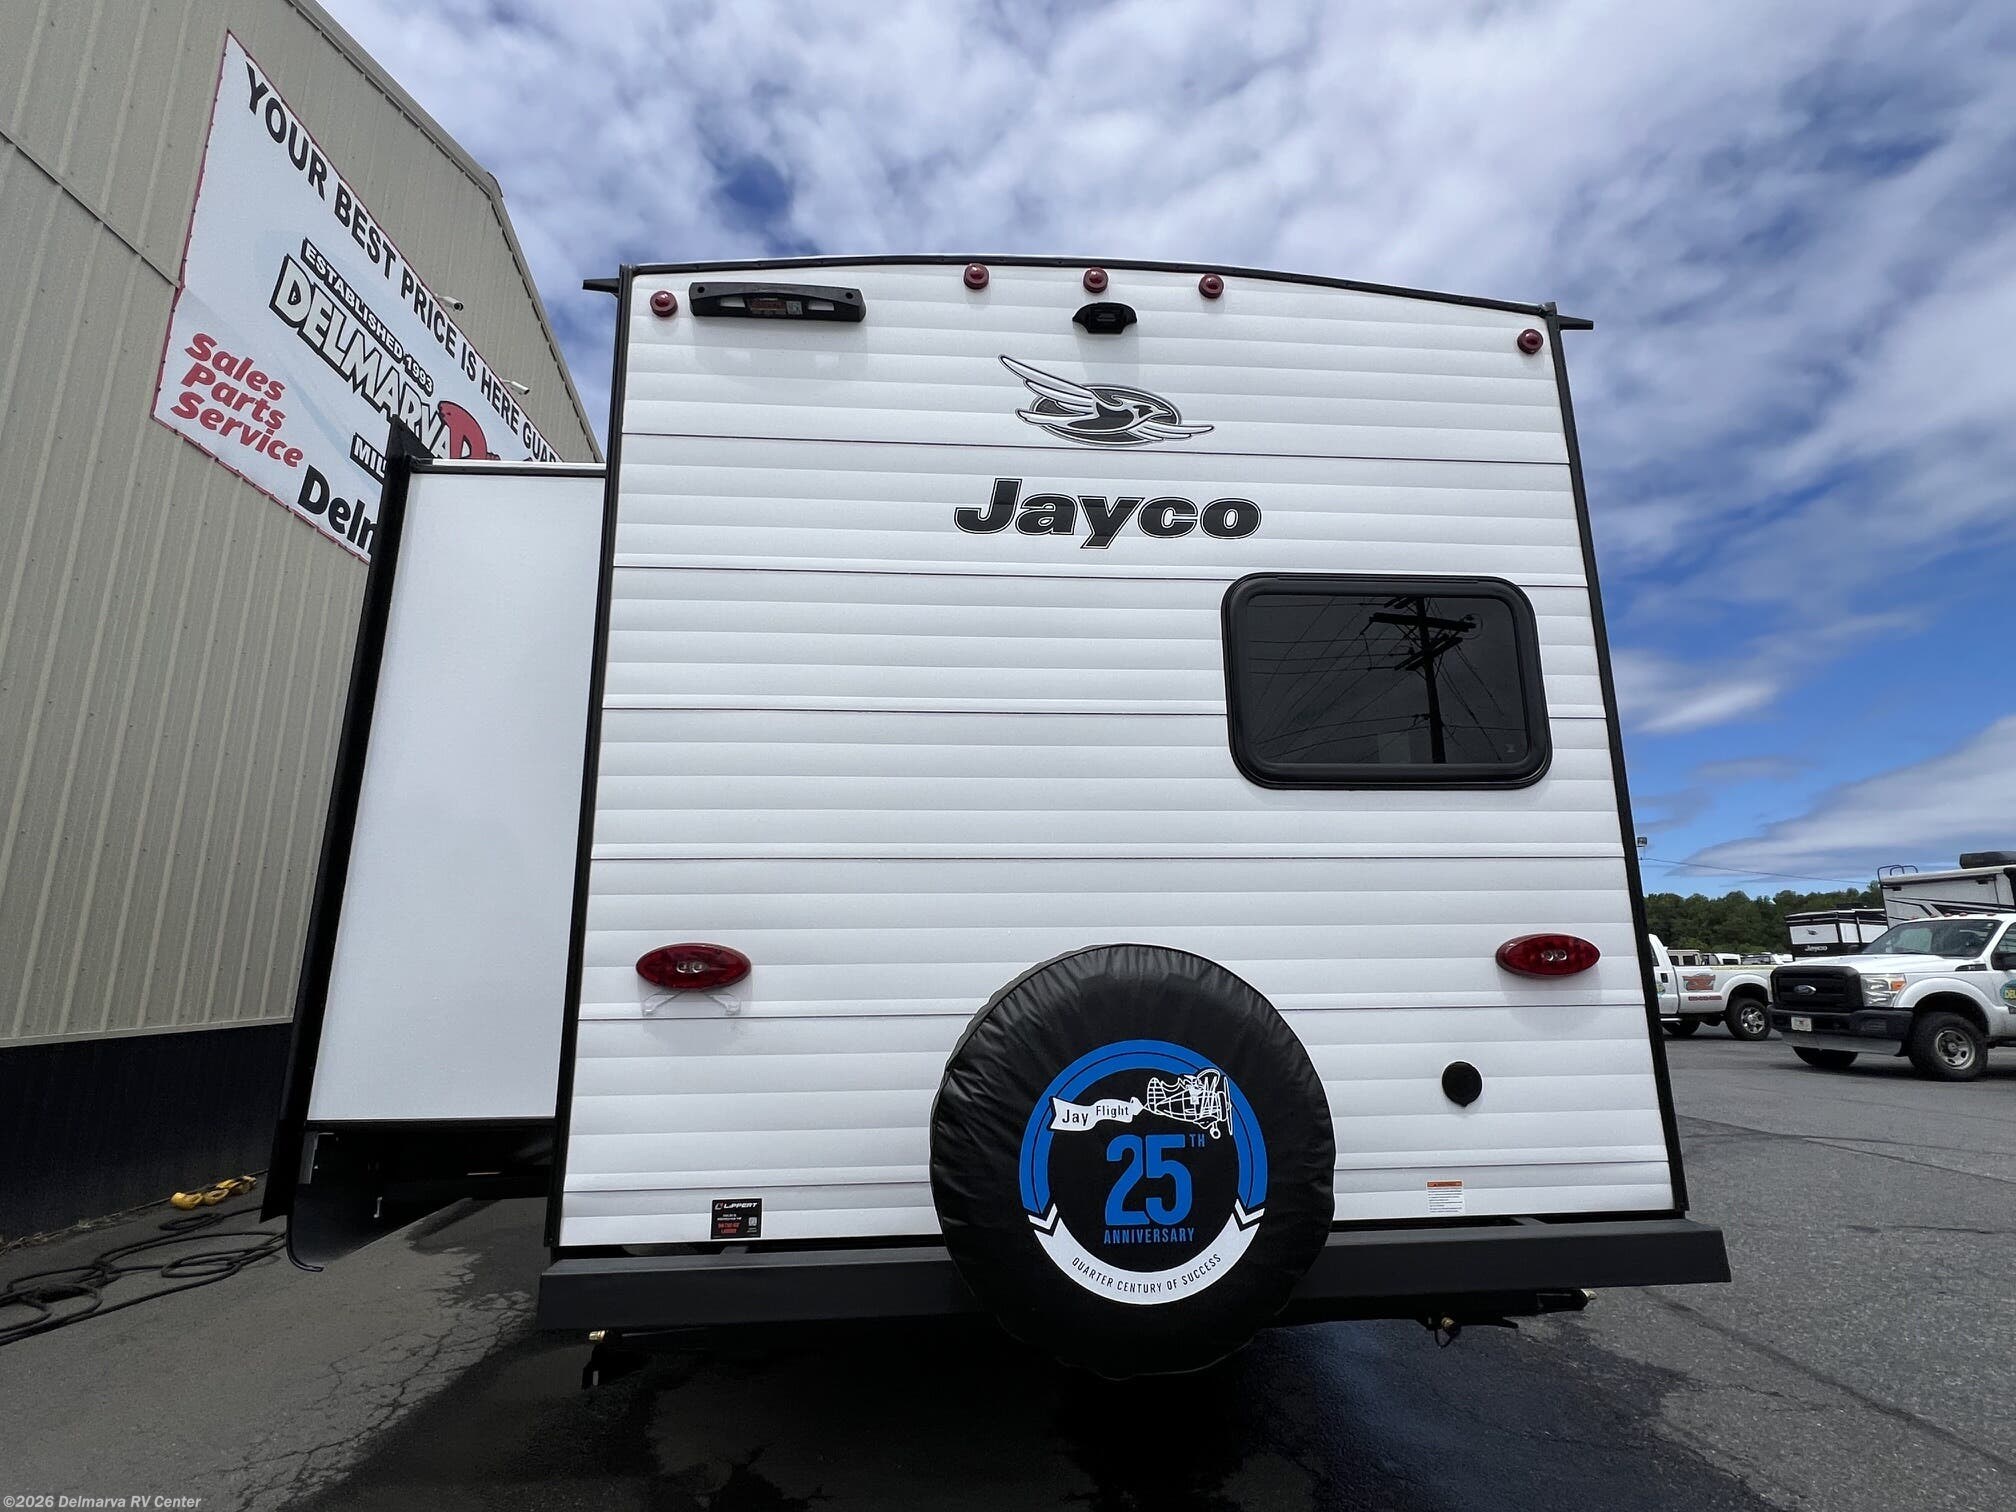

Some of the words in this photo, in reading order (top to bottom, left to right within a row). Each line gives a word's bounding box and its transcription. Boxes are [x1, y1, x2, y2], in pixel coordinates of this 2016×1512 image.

[245, 60, 327, 202] YOUR
[334, 182, 396, 280] BEST
[401, 266, 457, 359] PRICE
[461, 342, 477, 382] IS
[481, 366, 520, 435] HERE
[304, 246, 403, 360] ESTABLISHED
[405, 356, 434, 393] 1993
[184, 333, 286, 401] Sales
[270, 254, 451, 460] DELMARVA
[170, 391, 304, 468] Service
[181, 362, 286, 430] Parts
[353, 436, 387, 479] MIL
[953, 477, 1262, 550] Jayco
[1062, 1109, 1089, 1126] Jay
[1096, 1105, 1129, 1118] Flight
[1103, 1227, 1195, 1245] ANNIVERSARY
[1071, 1256, 1114, 1288] QUARTER
[1117, 1280, 1162, 1294] CENTURY
[1166, 1279, 1178, 1291] OF
[1182, 1253, 1222, 1286] SUCCESS
